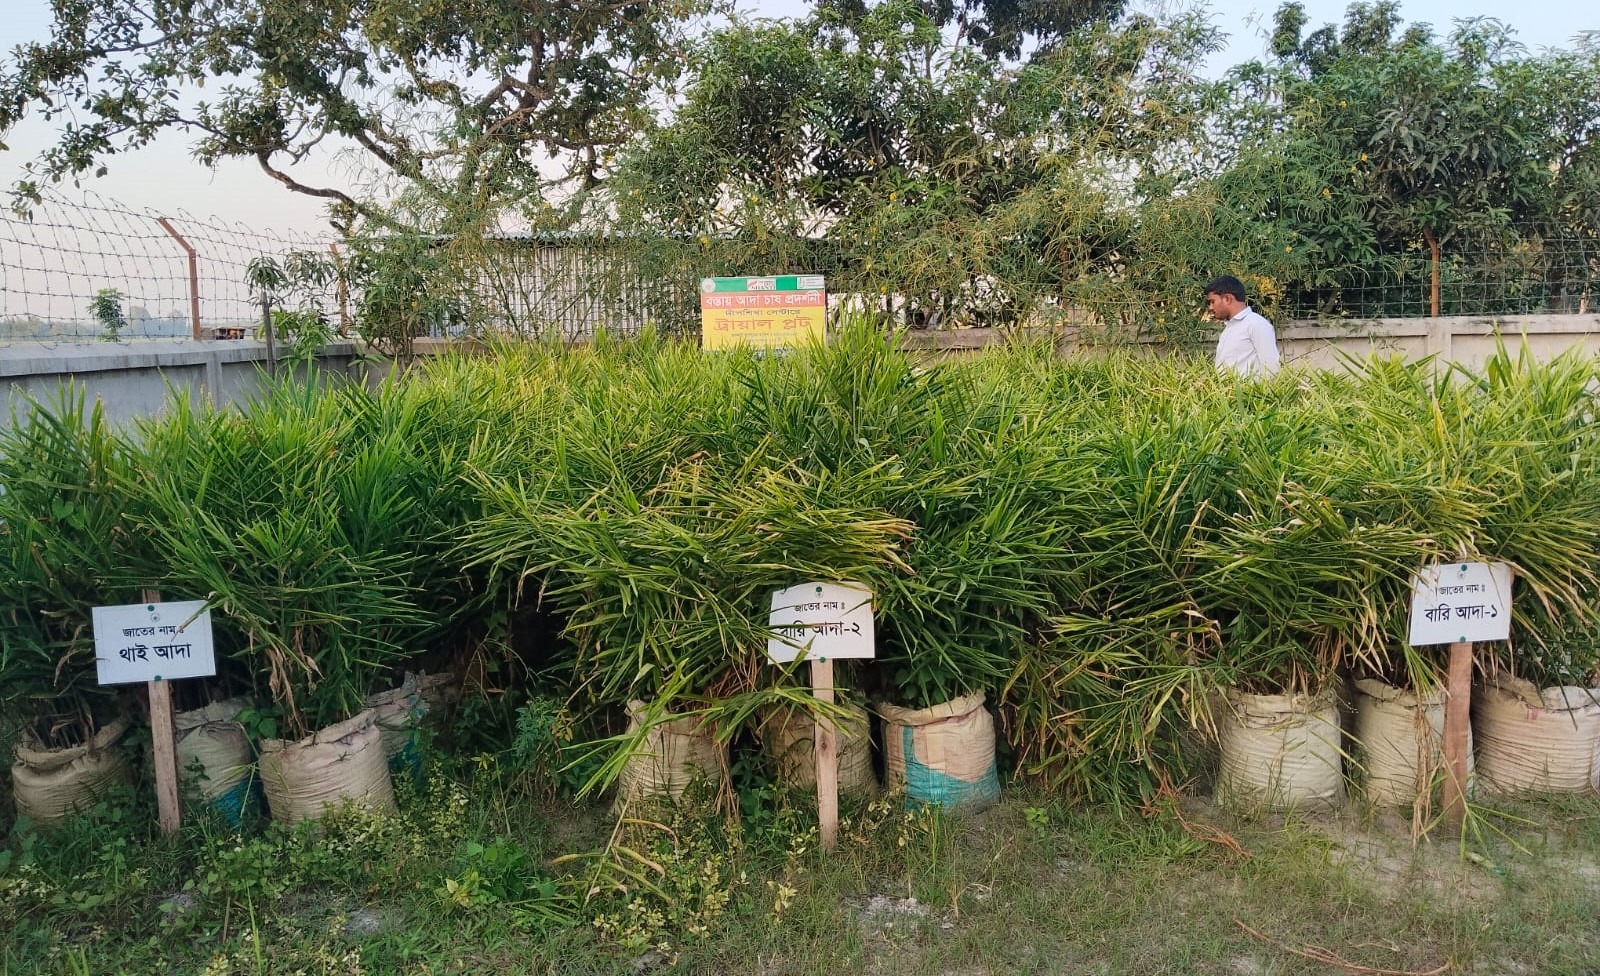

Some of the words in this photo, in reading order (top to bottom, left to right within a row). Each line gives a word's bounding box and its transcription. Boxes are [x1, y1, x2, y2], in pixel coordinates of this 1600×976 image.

[705, 296, 732, 307] বস্তায়
[736, 295, 761, 305] আদা
[764, 294, 781, 305] চাষ
[784, 290, 821, 305] প্রদর্শনী
[714, 317, 774, 332] ট্রায়াল
[782, 316, 813, 330] প্লট
[1439, 585, 1464, 595] জাতের
[1466, 584, 1480, 593] নাম
[794, 601, 820, 613] জাতের
[823, 601, 839, 610] নাম
[1424, 603, 1451, 623] বারি
[1455, 604, 1498, 620] আদা-১
[122, 626, 155, 638] জাতের
[158, 625, 177, 635] নাম
[119, 643, 149, 663] থাই
[153, 643, 192, 660] আদা
